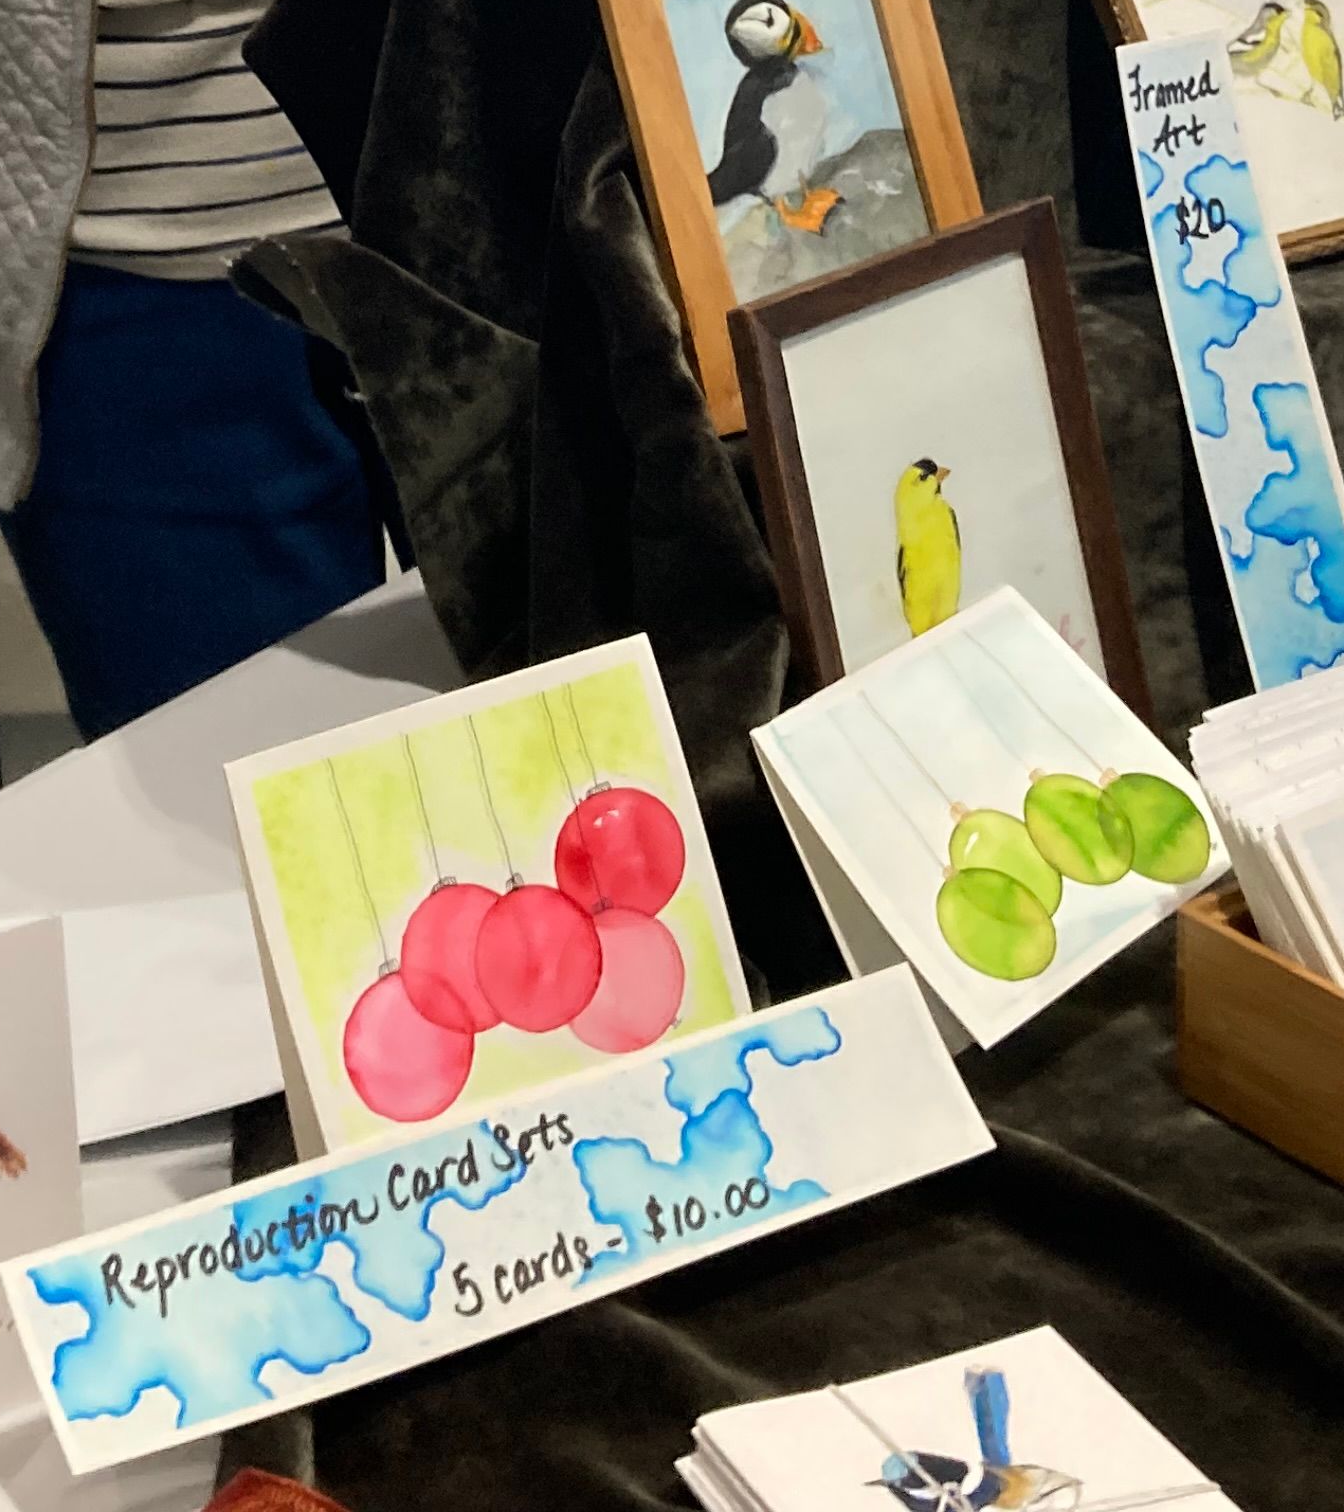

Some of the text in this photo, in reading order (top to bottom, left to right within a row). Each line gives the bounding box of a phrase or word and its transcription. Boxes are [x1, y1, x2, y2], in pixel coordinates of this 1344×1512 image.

[1127, 60, 1220, 113] Framed
[1152, 114, 1206, 157] Art
[1176, 196, 1226, 245] $20
[100, 1113, 575, 1319] Reproduction Card Sets
[452, 1261, 485, 1317] 5
[493, 1231, 594, 1304] cards
[643, 1177, 771, 1243] $10.00
